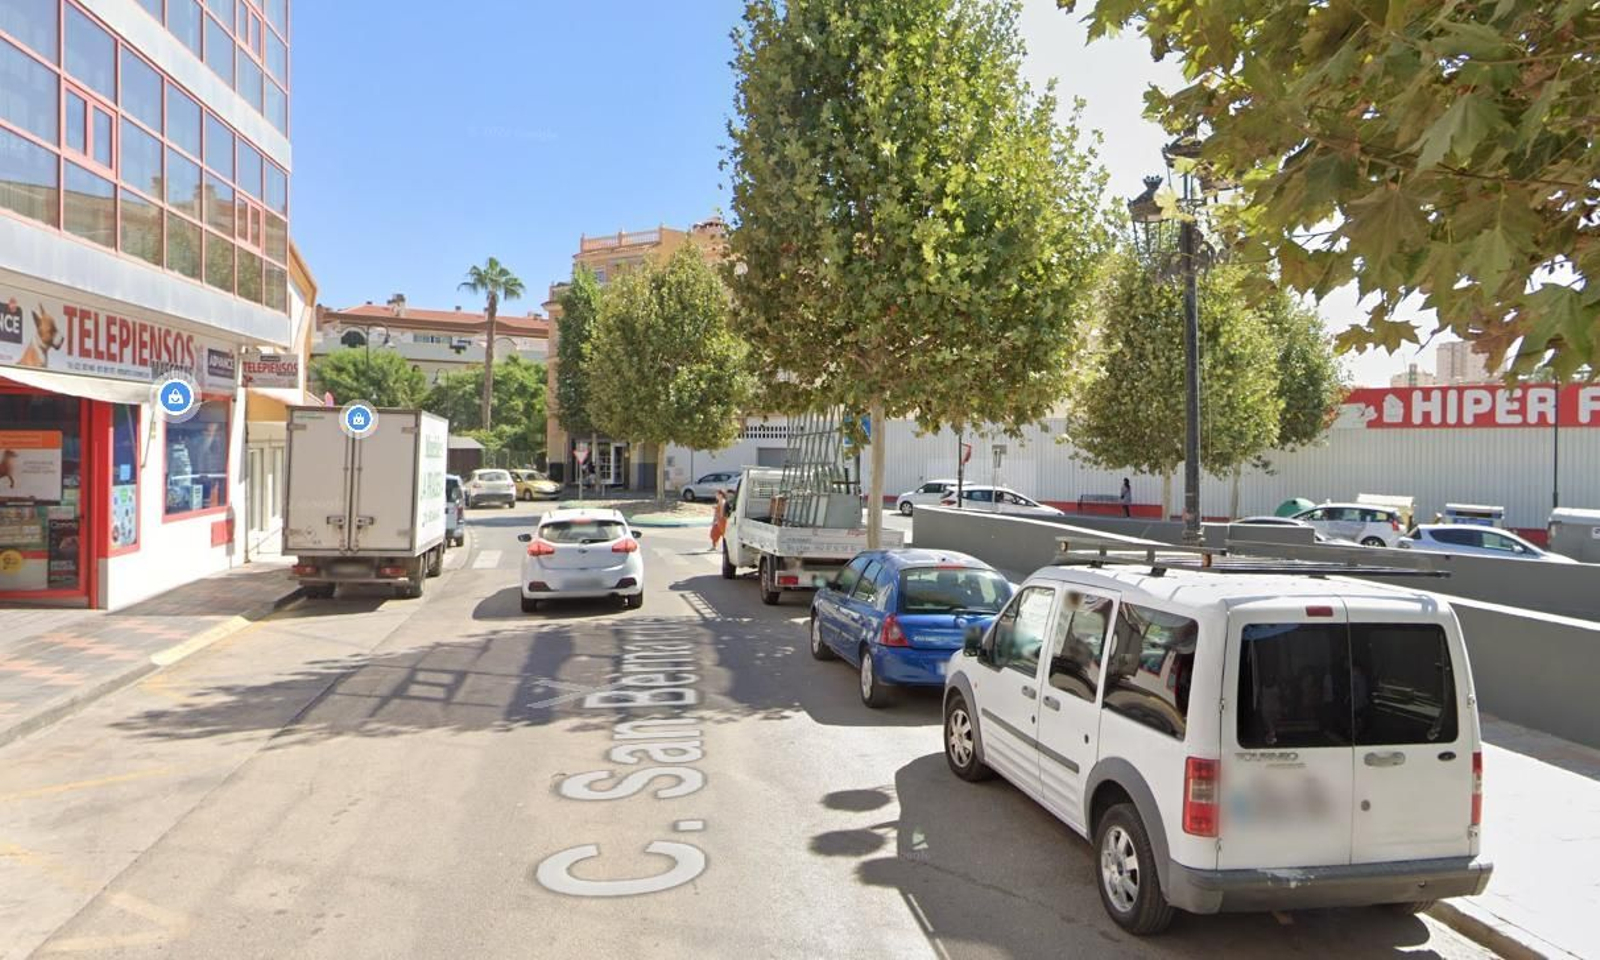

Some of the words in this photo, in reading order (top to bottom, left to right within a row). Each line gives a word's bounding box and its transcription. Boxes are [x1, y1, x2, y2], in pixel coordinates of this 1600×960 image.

[63, 305, 195, 369] TELEPIENSOS
[243, 361, 298, 374] TELEPIENSOS
[1412, 387, 1555, 424] HIPER
